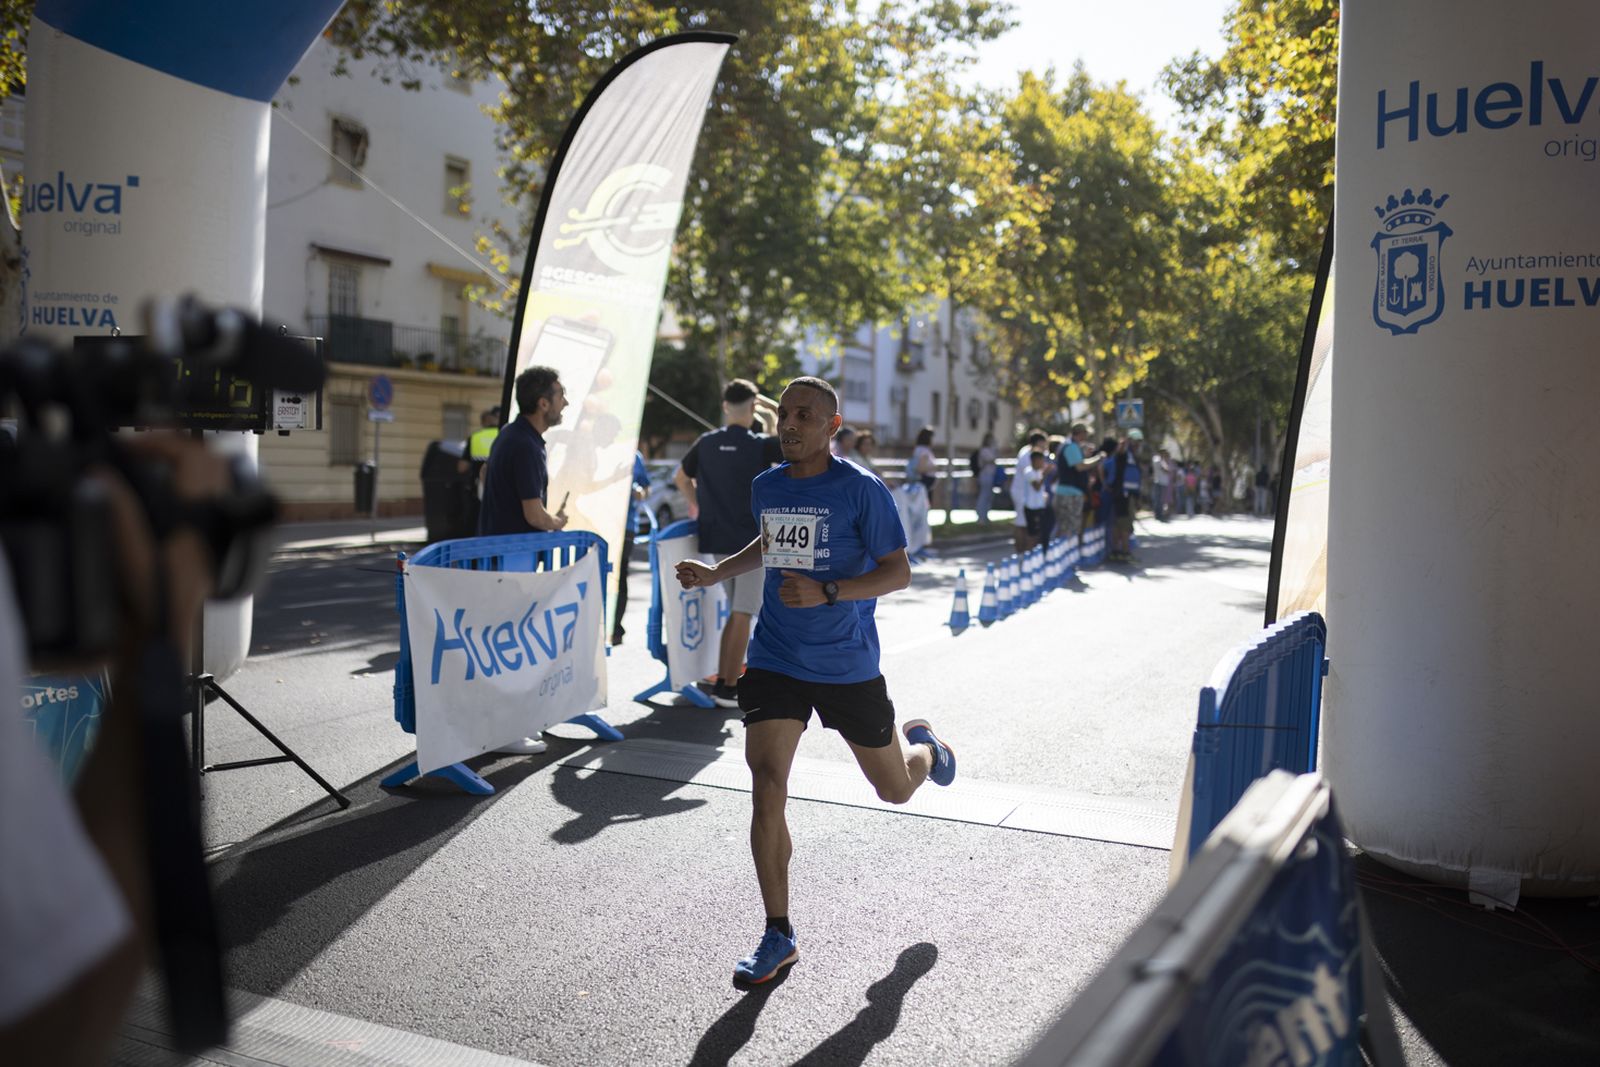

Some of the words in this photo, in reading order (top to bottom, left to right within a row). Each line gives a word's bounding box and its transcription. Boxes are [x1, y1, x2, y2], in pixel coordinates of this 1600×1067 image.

[1376, 60, 1600, 150] Huelv
[1543, 133, 1600, 161] orig
[24, 171, 121, 215] uelva
[63, 220, 121, 237] original
[32, 291, 99, 303] Ayuntamiento
[103, 293, 119, 304] de
[1464, 276, 1600, 310] HUELV
[32, 306, 117, 328] HUELVA
[797, 506, 830, 515] HUELVA
[775, 525, 809, 548] 449
[815, 548, 830, 559] ING
[431, 601, 579, 685] Huelva
[22, 686, 79, 709] ortes
